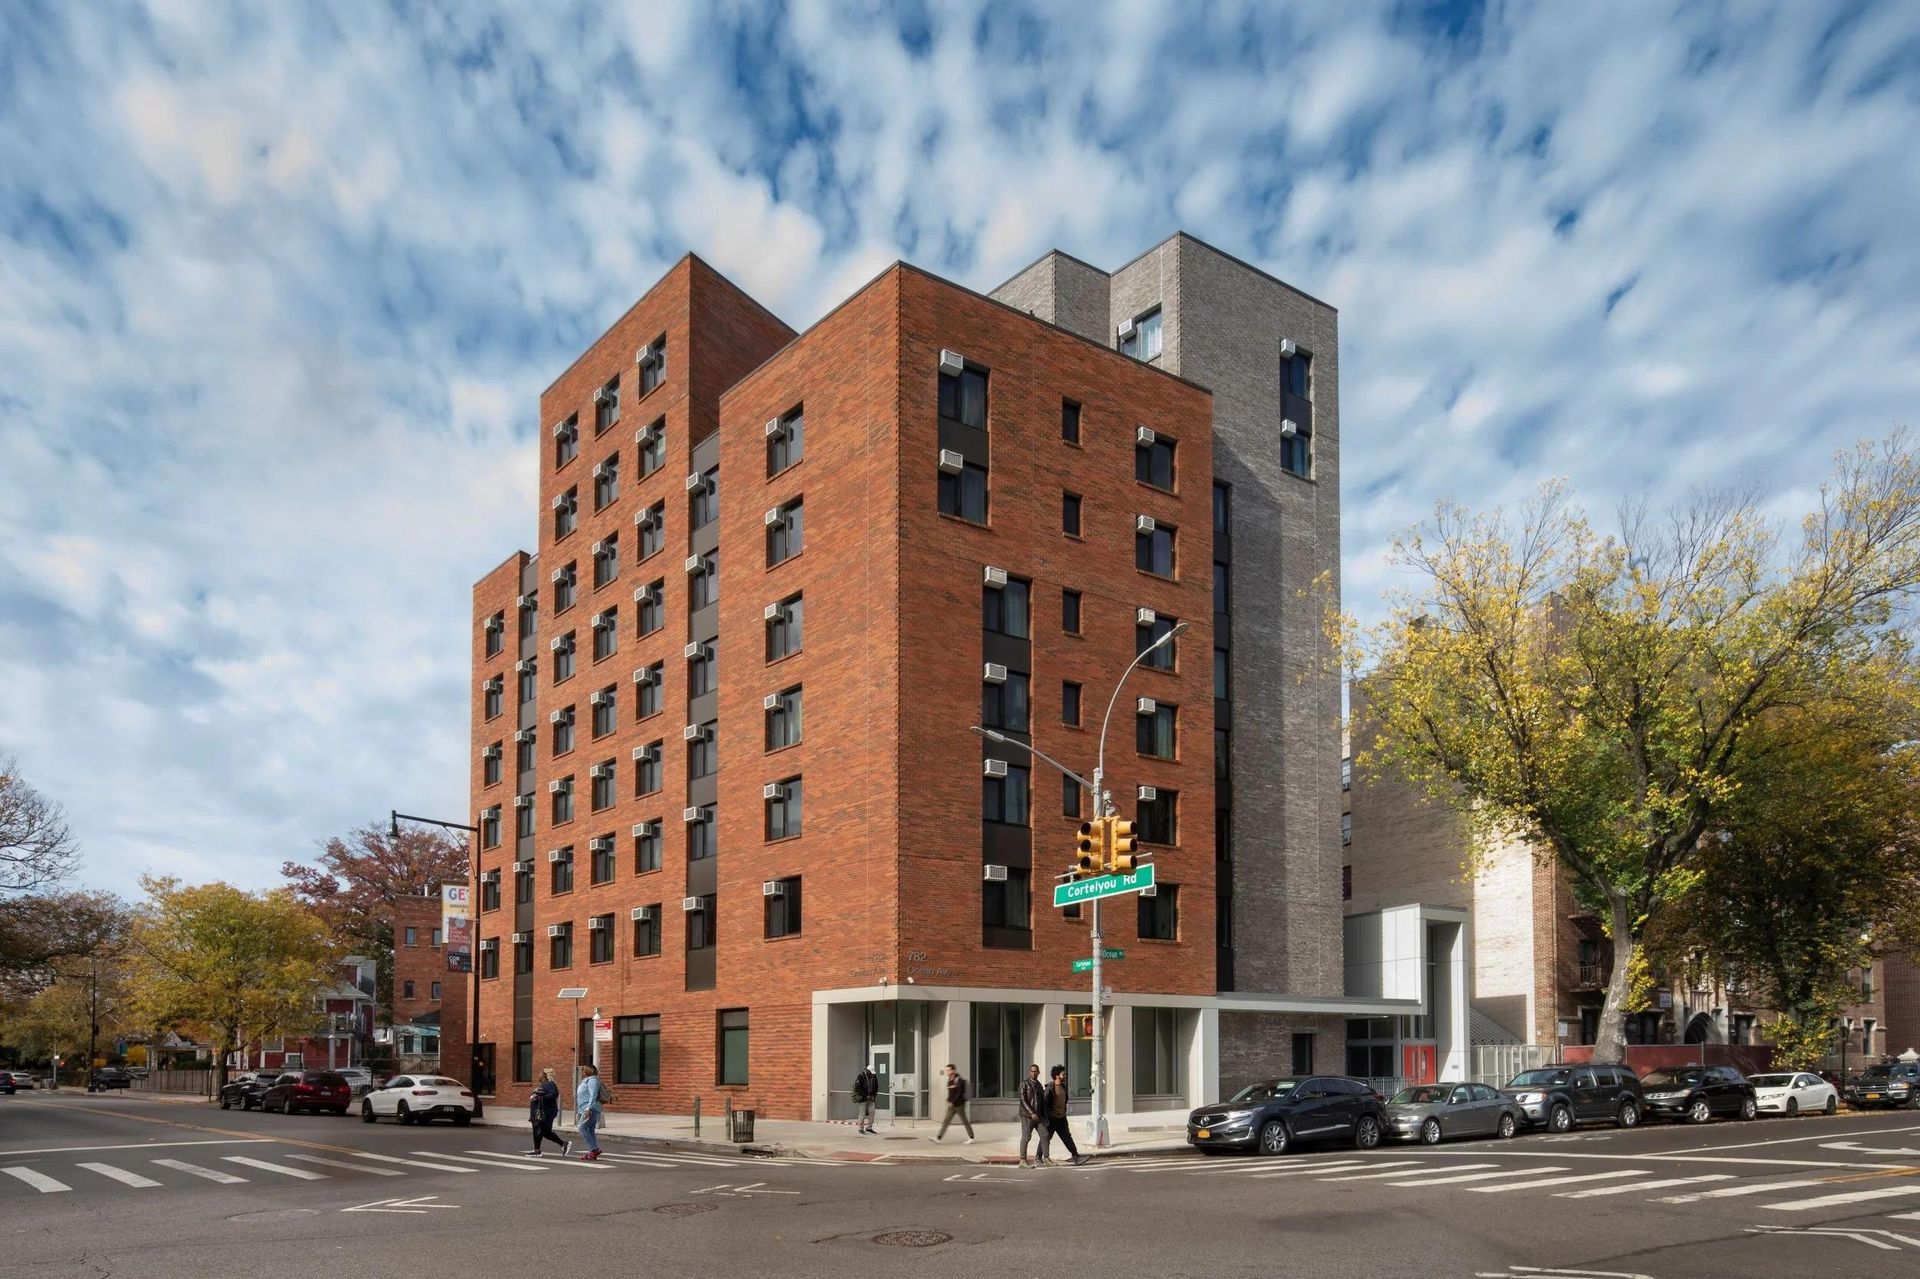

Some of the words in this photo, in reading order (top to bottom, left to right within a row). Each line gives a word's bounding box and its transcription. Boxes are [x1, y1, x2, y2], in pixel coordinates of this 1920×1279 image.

[1067, 879, 1117, 898] Cortelyou
[1123, 873, 1137, 886] Rd
[449, 888, 469, 900] GE
[908, 951, 927, 961] 782
[1103, 949, 1118, 959] Ocean
[907, 965, 934, 976] Ocean
